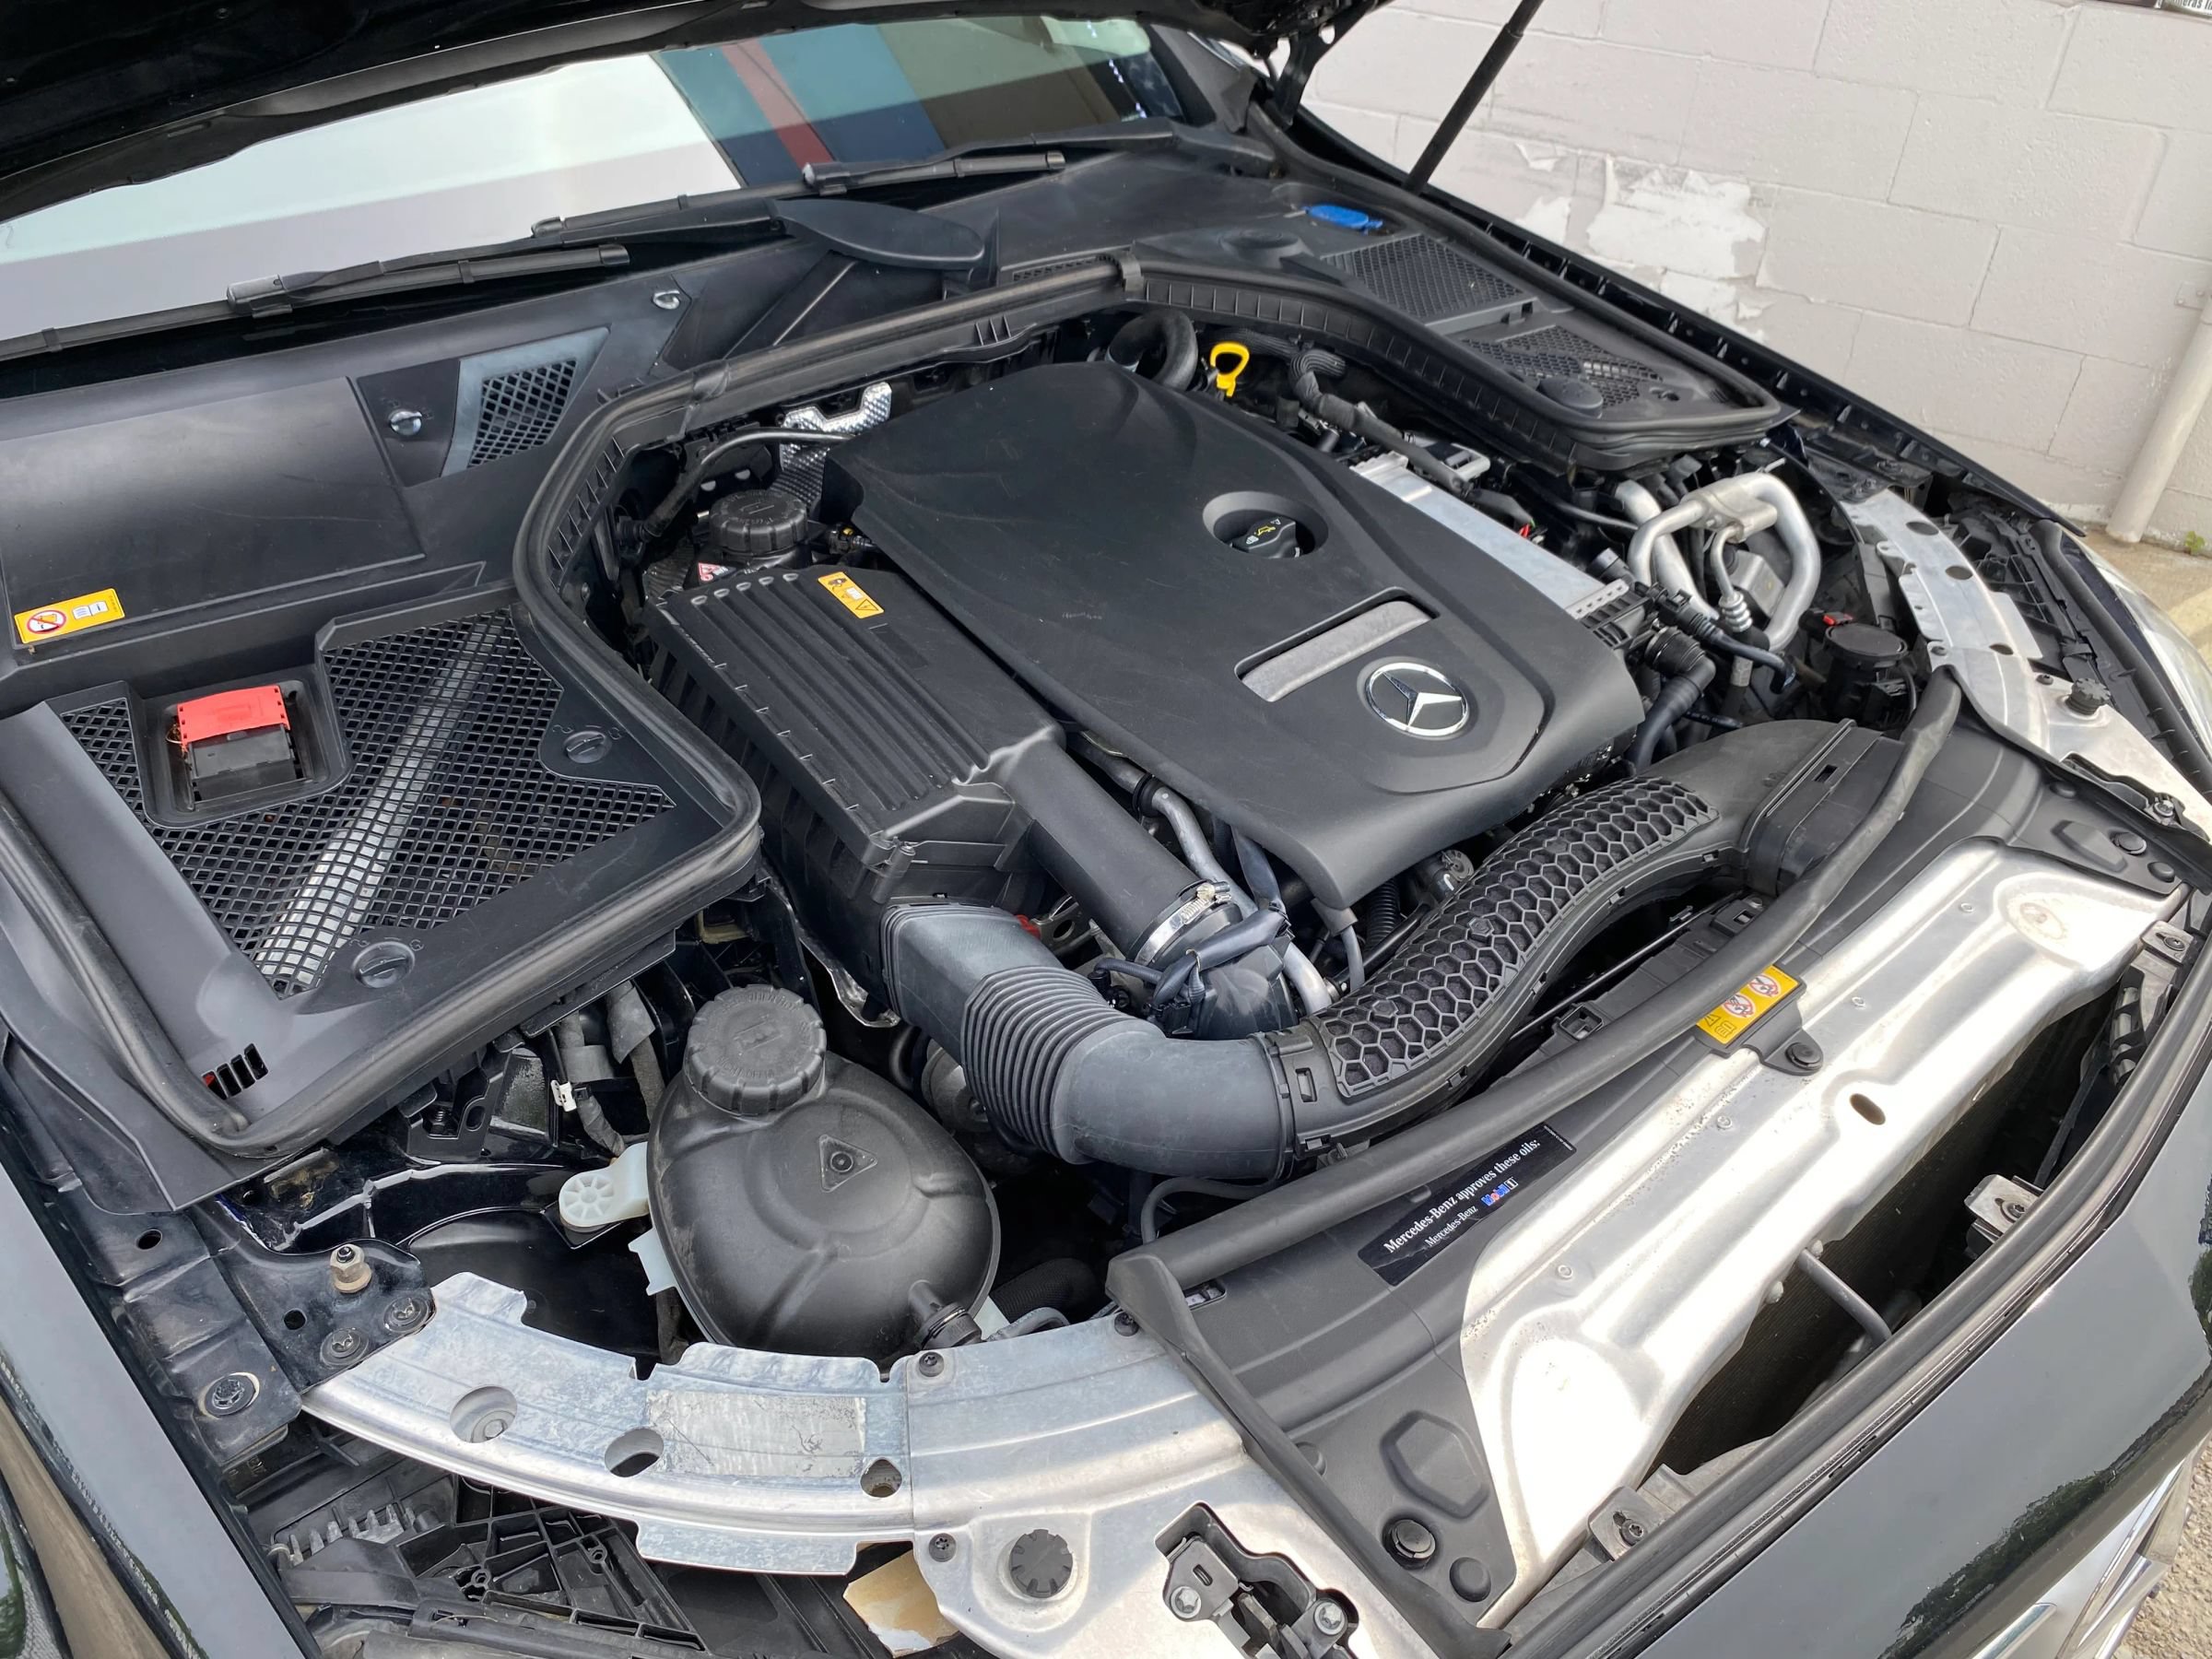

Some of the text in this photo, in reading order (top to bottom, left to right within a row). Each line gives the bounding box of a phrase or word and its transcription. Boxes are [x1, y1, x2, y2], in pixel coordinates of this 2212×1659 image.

[1382, 1138, 1541, 1253] Mercedes-Benz approves these oils:
[1424, 1205, 1478, 1248] Mercedes-Benz
[1480, 1183, 1511, 1206] Mobil
